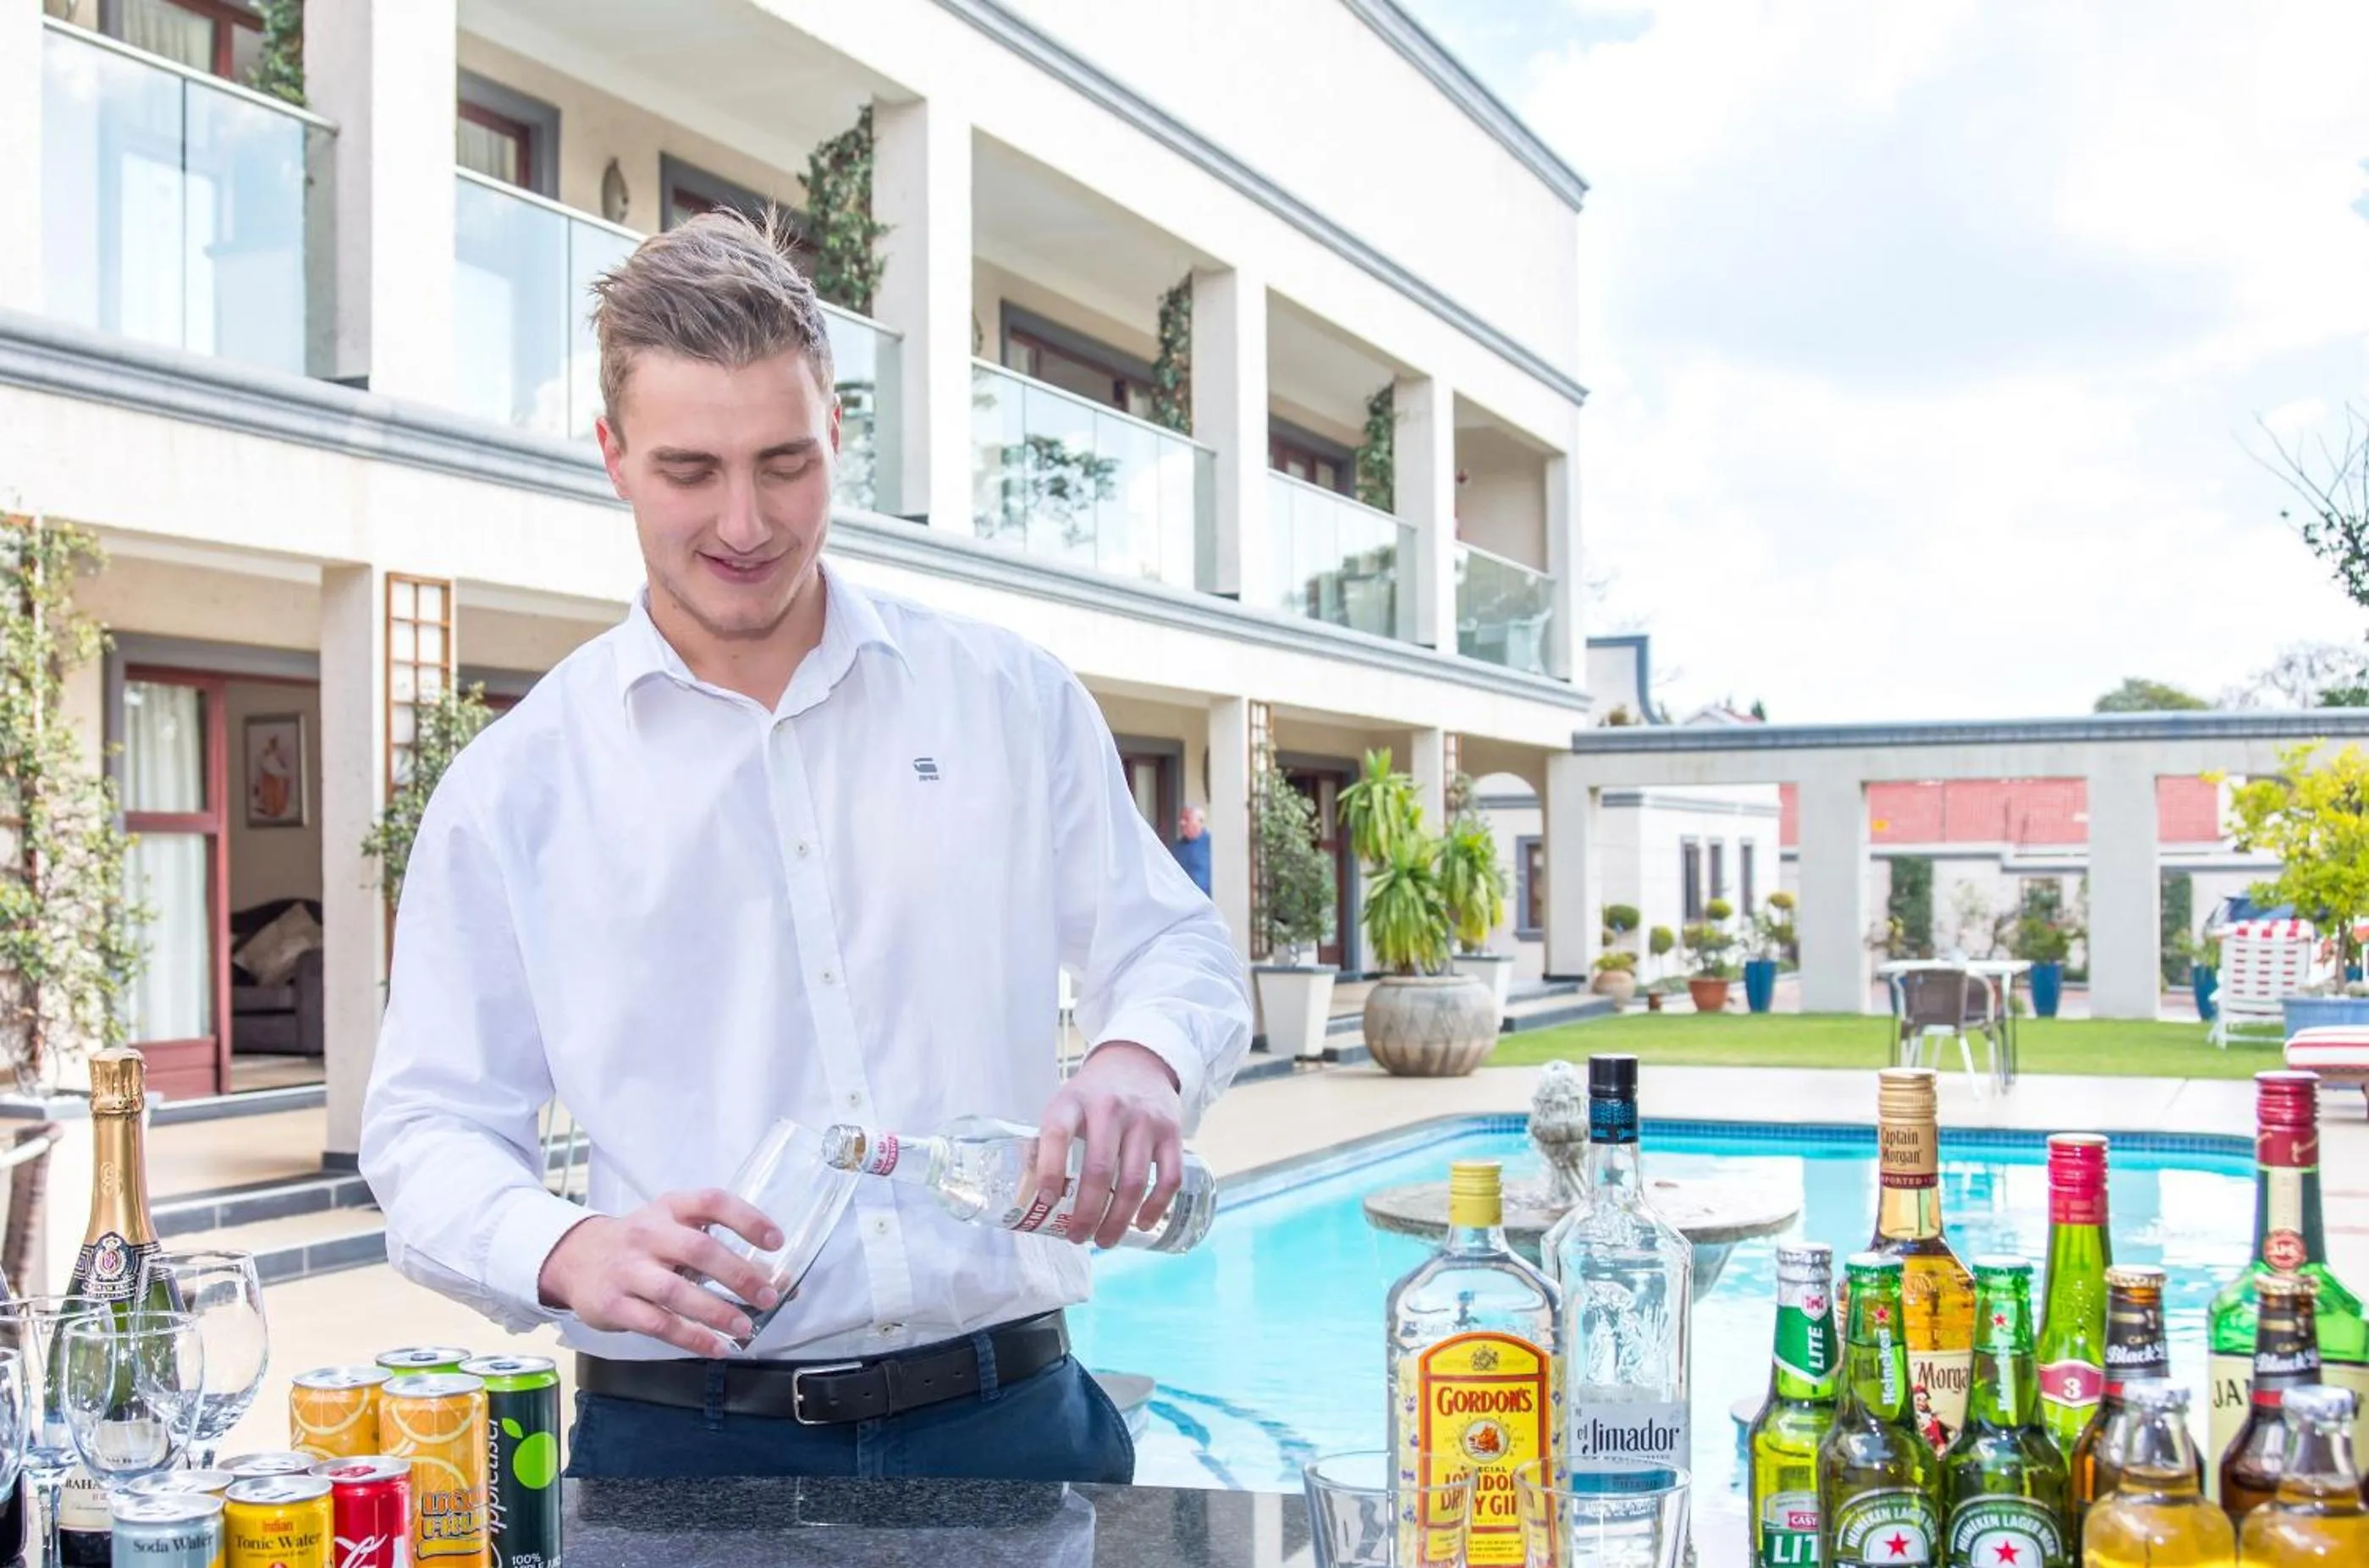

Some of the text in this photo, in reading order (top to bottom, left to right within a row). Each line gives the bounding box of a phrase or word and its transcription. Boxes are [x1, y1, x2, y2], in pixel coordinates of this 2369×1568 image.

[1881, 1175, 1923, 1186] PORTED
[1807, 1326, 1825, 1369] LITE
[2106, 1344, 2155, 1364] Black
[1877, 1328, 1897, 1405] Heineken
[1919, 1361, 1970, 1394] Morga
[1995, 1334, 2013, 1411] Heineke
[1437, 1386, 1533, 1417] GORDON'S
[2063, 1378, 2081, 1399] 3
[1577, 1417, 1680, 1455] el Jimador
[1790, 1515, 1819, 1527] CAST
[1957, 1513, 2000, 1553] HEINEKEN
[2002, 1514, 2041, 1537] LAGER
[133, 1535, 213, 1554] Soda Water
[234, 1532, 322, 1550] Tonic Water
[1772, 1533, 1819, 1564] LIT
[510, 1552, 542, 1566] 100%
